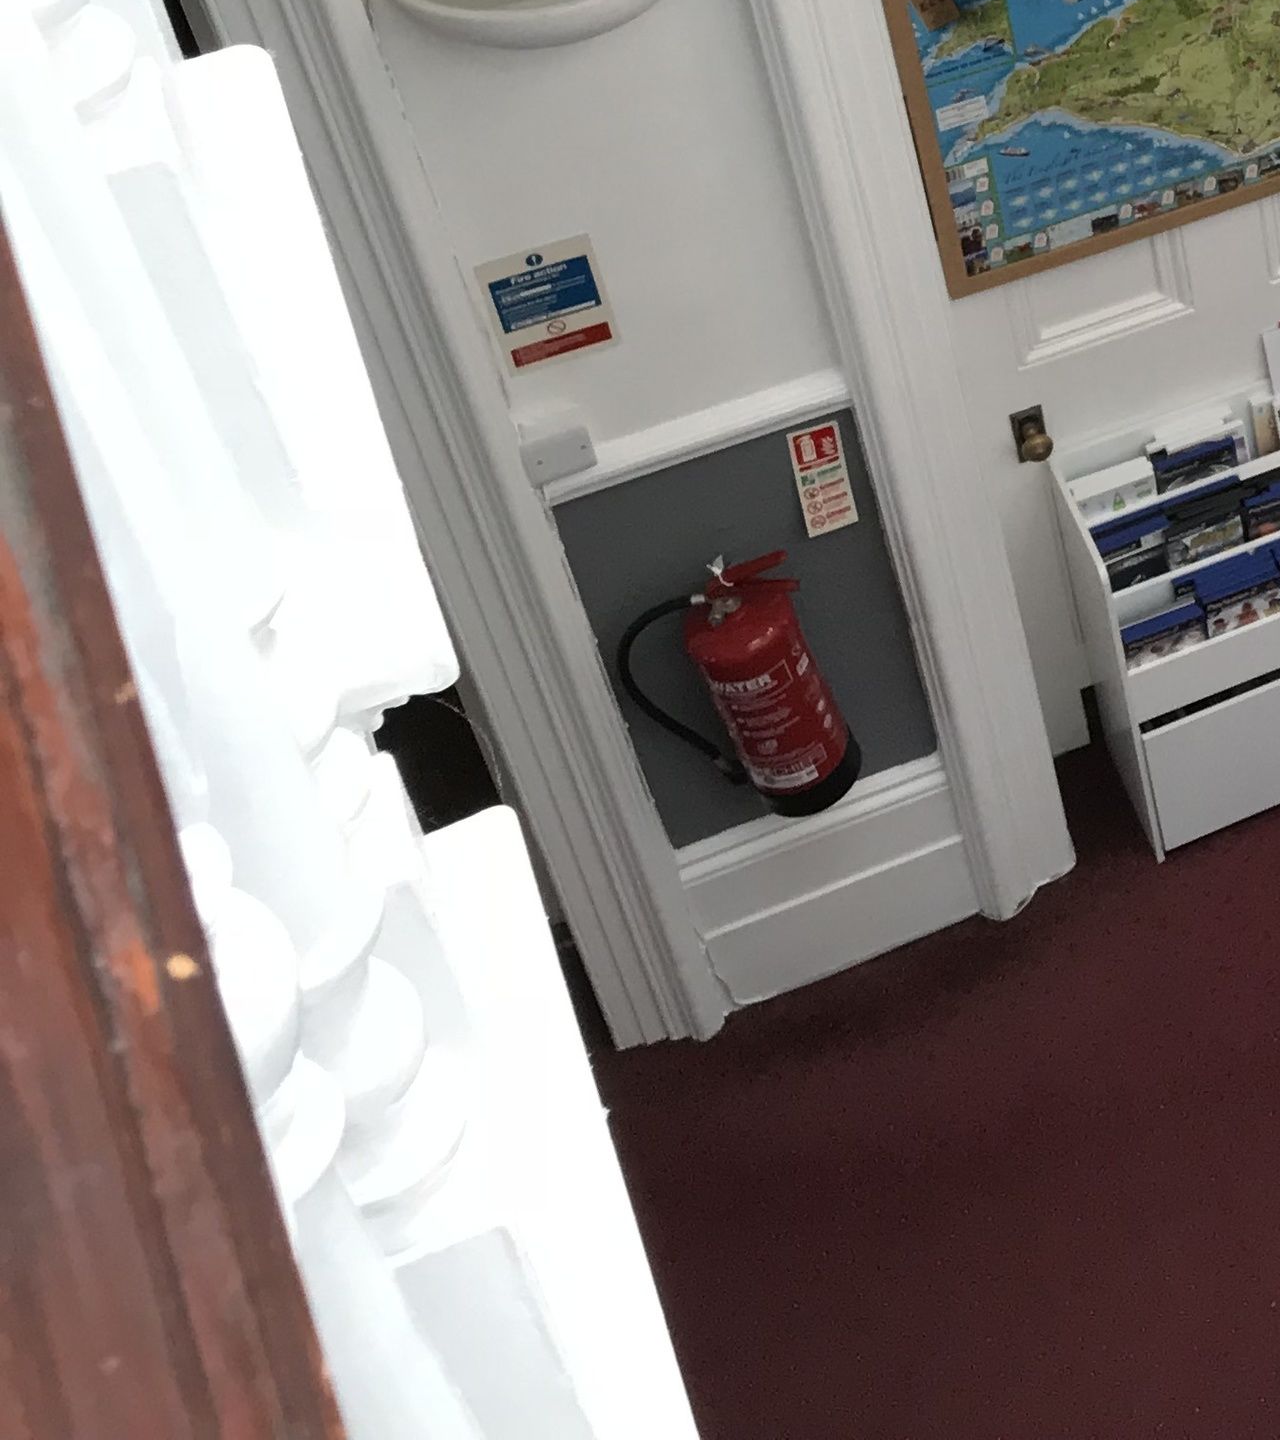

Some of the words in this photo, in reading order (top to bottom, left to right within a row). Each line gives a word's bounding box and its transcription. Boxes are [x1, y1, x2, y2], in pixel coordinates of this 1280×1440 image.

[510, 274, 532, 286] Fire
[533, 263, 568, 279] action
[710, 673, 772, 693] WATER
